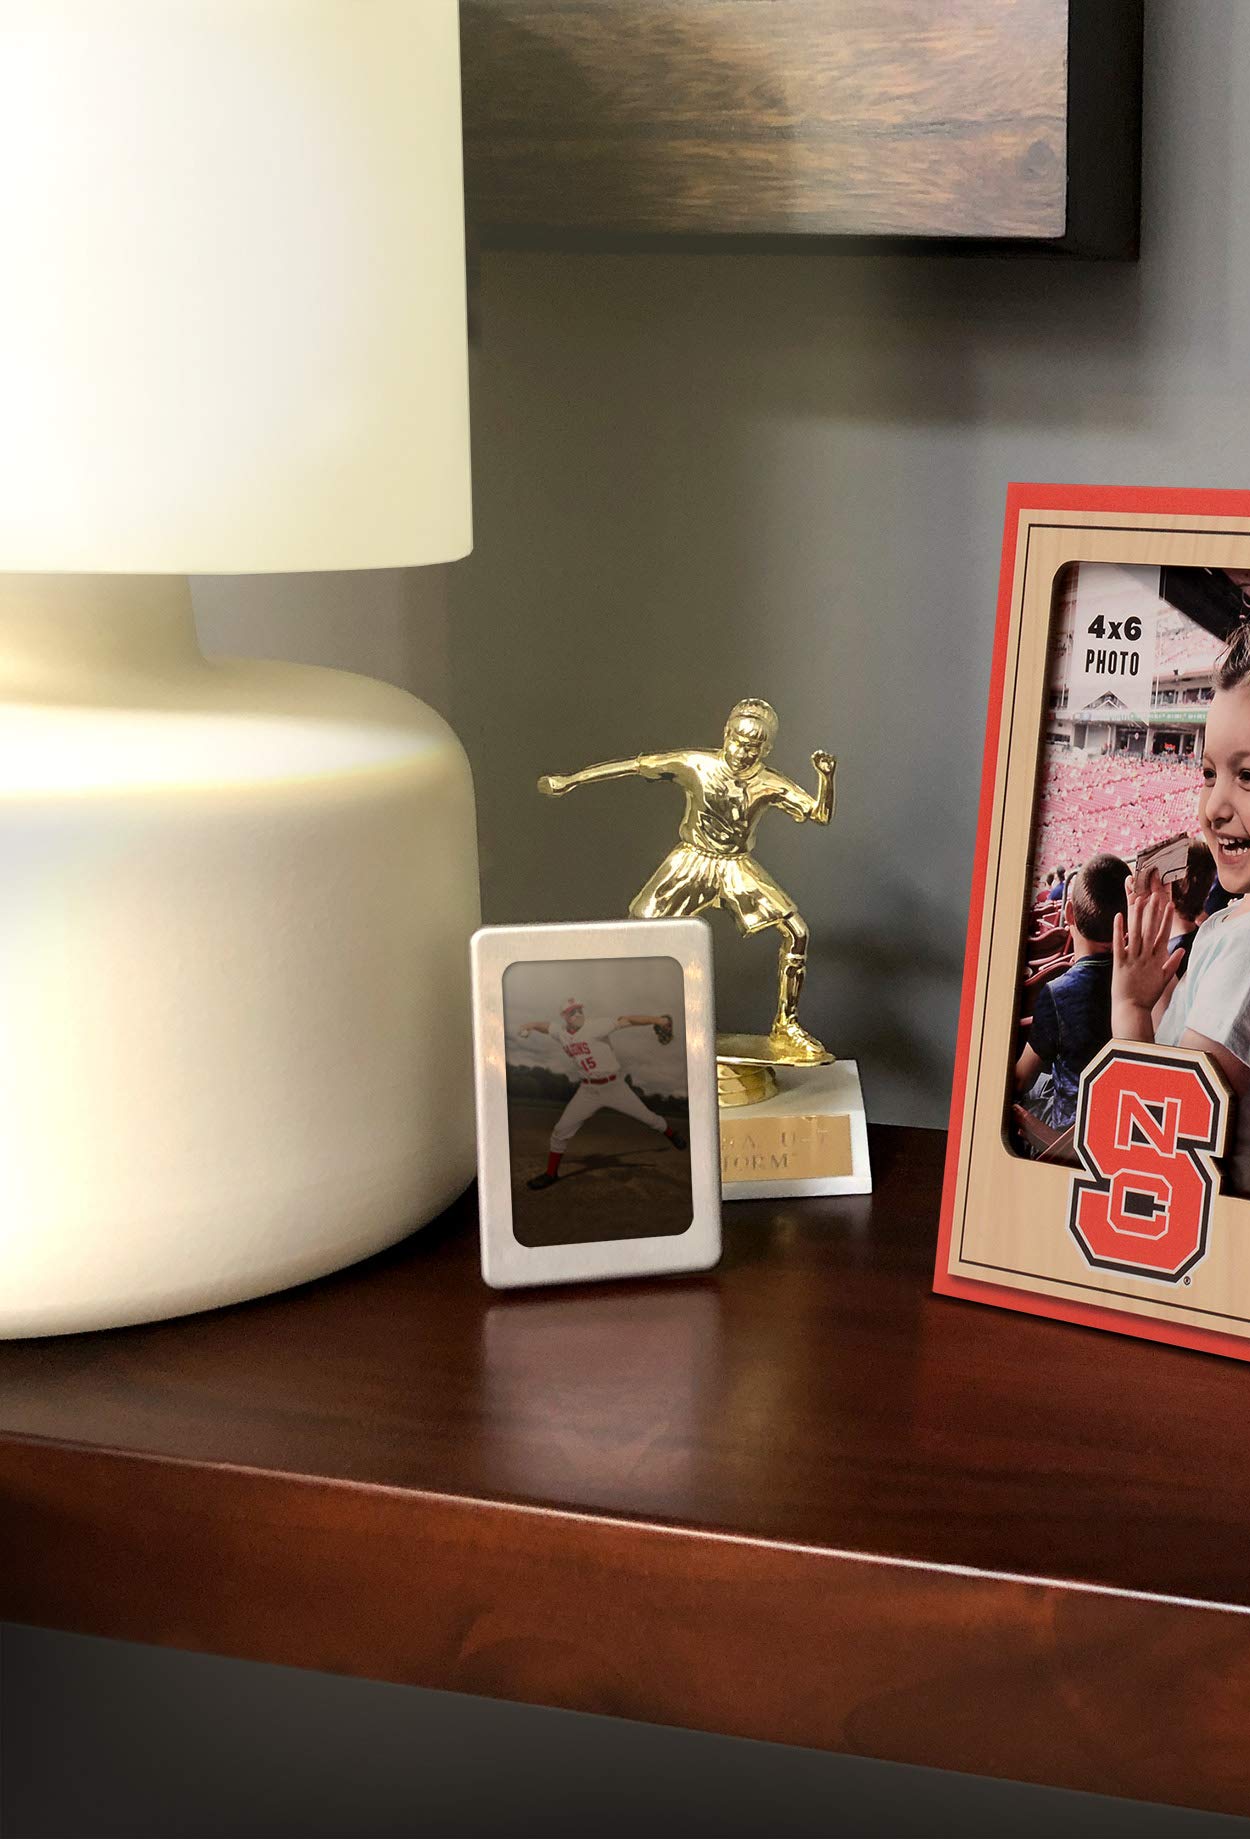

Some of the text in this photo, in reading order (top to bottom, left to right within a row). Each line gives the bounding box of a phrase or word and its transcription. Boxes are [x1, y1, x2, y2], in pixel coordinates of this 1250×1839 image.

[1087, 614, 1142, 641] 4x6
[1085, 648, 1140, 677] PHOTO
[580, 1056, 597, 1074] 15
